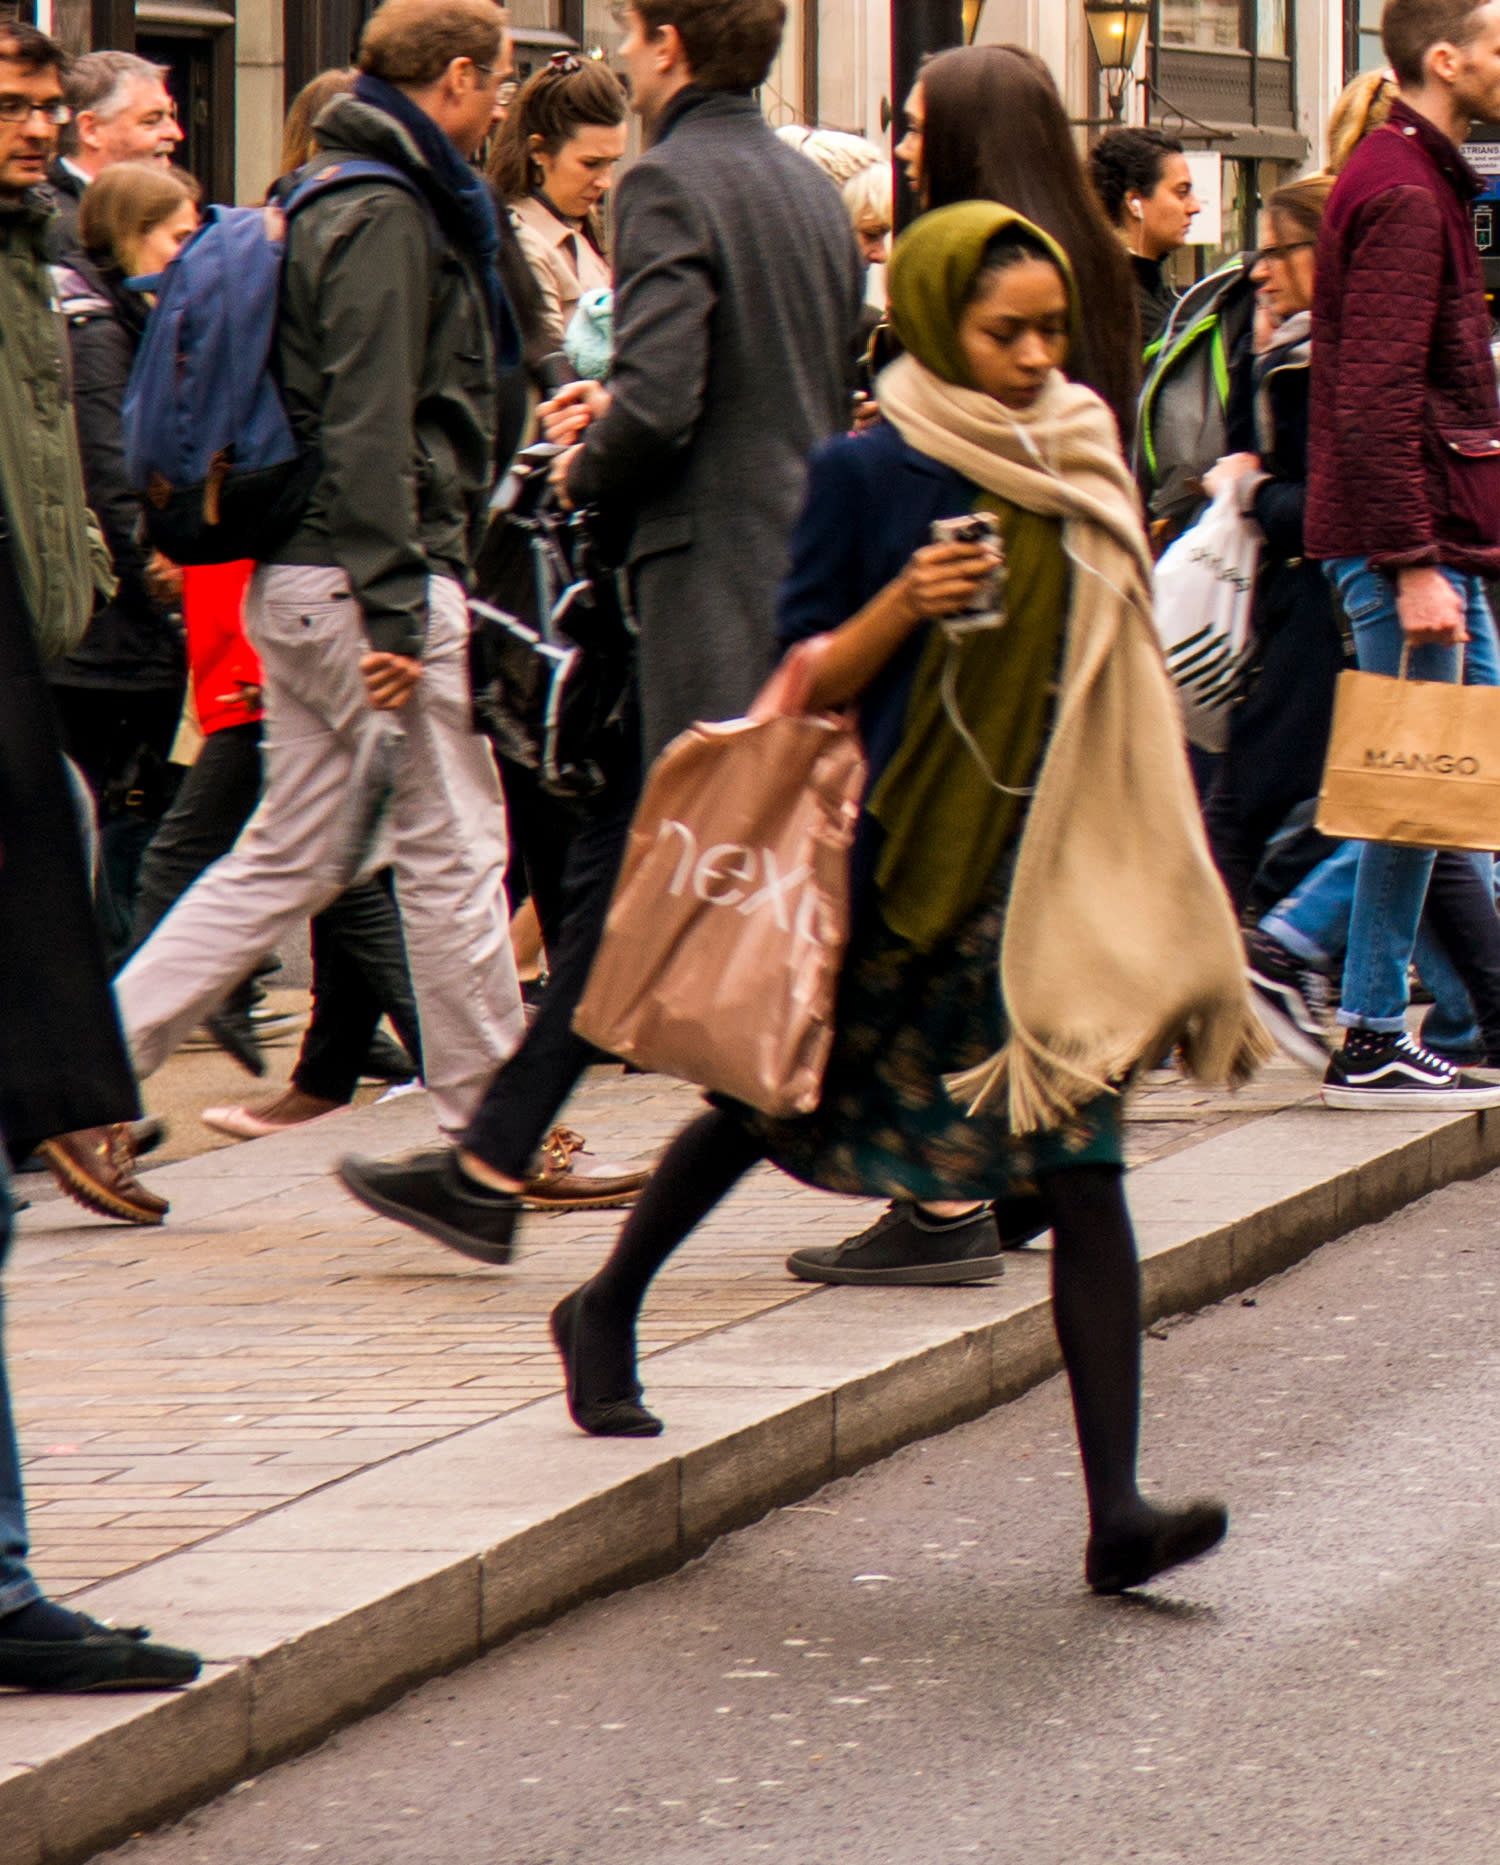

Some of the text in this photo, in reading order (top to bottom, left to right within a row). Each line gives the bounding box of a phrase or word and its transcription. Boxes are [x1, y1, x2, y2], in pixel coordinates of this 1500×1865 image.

[1461, 146, 1500, 154] STRIANS
[1363, 749, 1480, 775] MANGO
[659, 818, 836, 947] next
